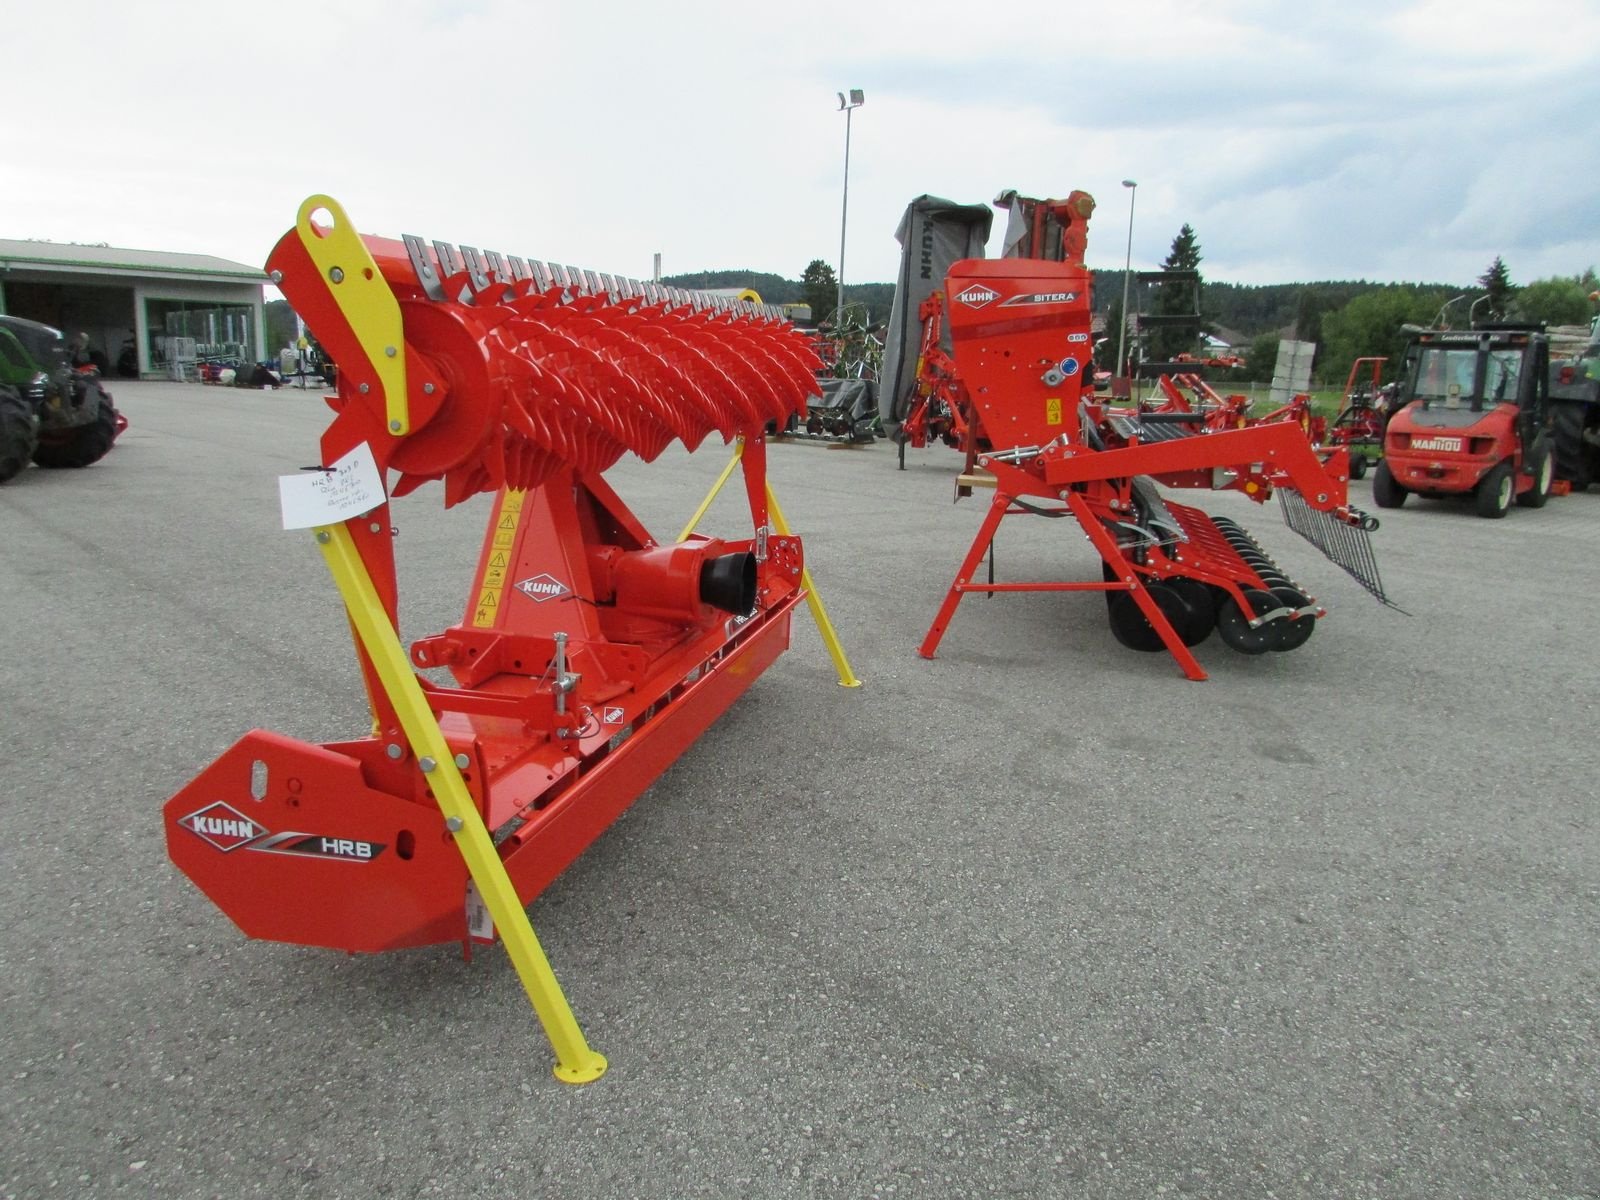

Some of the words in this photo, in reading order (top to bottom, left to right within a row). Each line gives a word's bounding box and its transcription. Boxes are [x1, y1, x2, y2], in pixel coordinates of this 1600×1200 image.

[921, 221, 933, 279] KUHN
[961, 292, 994, 302] KUHN
[1034, 292, 1075, 302] SITERA
[1412, 436, 1462, 452] MANITOU
[523, 582, 561, 595] KUHN
[192, 816, 254, 838] KUHN
[321, 837, 372, 858] HRB
